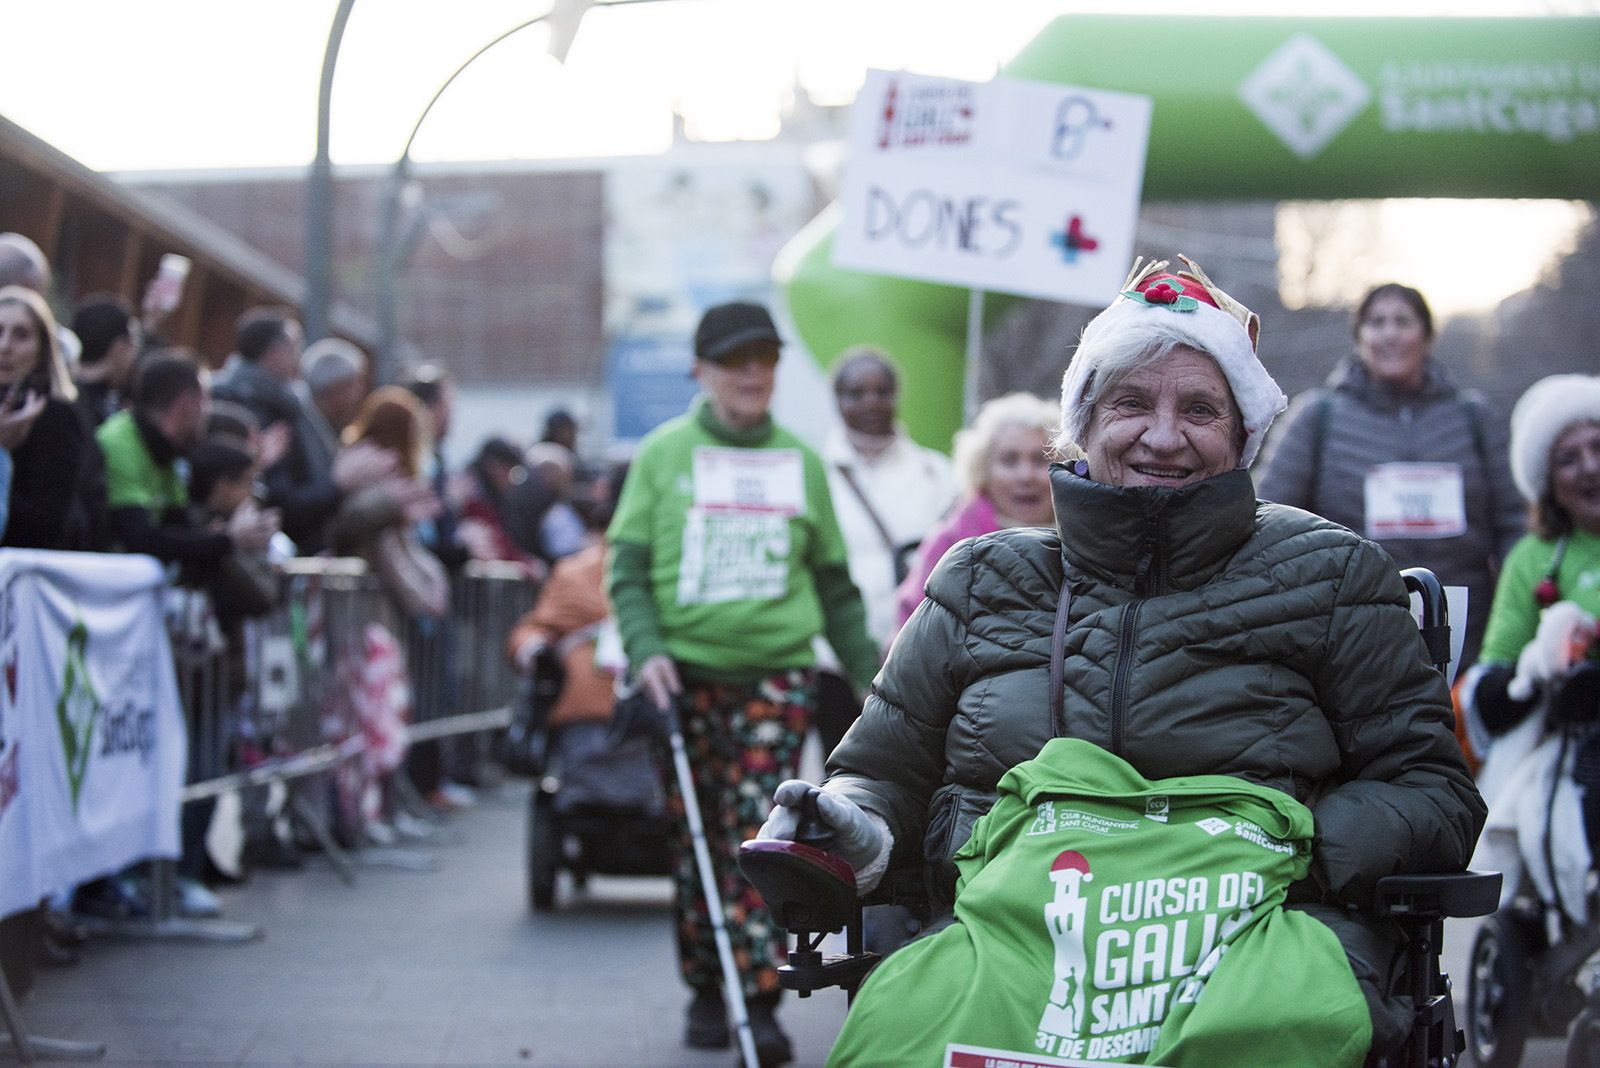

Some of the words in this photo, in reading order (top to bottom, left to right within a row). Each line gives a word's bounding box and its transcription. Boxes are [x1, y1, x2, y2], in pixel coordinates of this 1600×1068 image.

[864, 185, 1023, 258] DONES
[1149, 801, 1165, 809] eco
[1060, 812, 1080, 821] CLUB
[1081, 814, 1139, 830] MUNTANYENC
[1060, 820, 1081, 829] SANT
[1081, 822, 1110, 833] CUGAT
[1099, 877, 1209, 925] CURSA
[1090, 982, 1171, 1035] SANT
[1035, 1031, 1057, 1053] 31
[1057, 1038, 1086, 1060] DE
